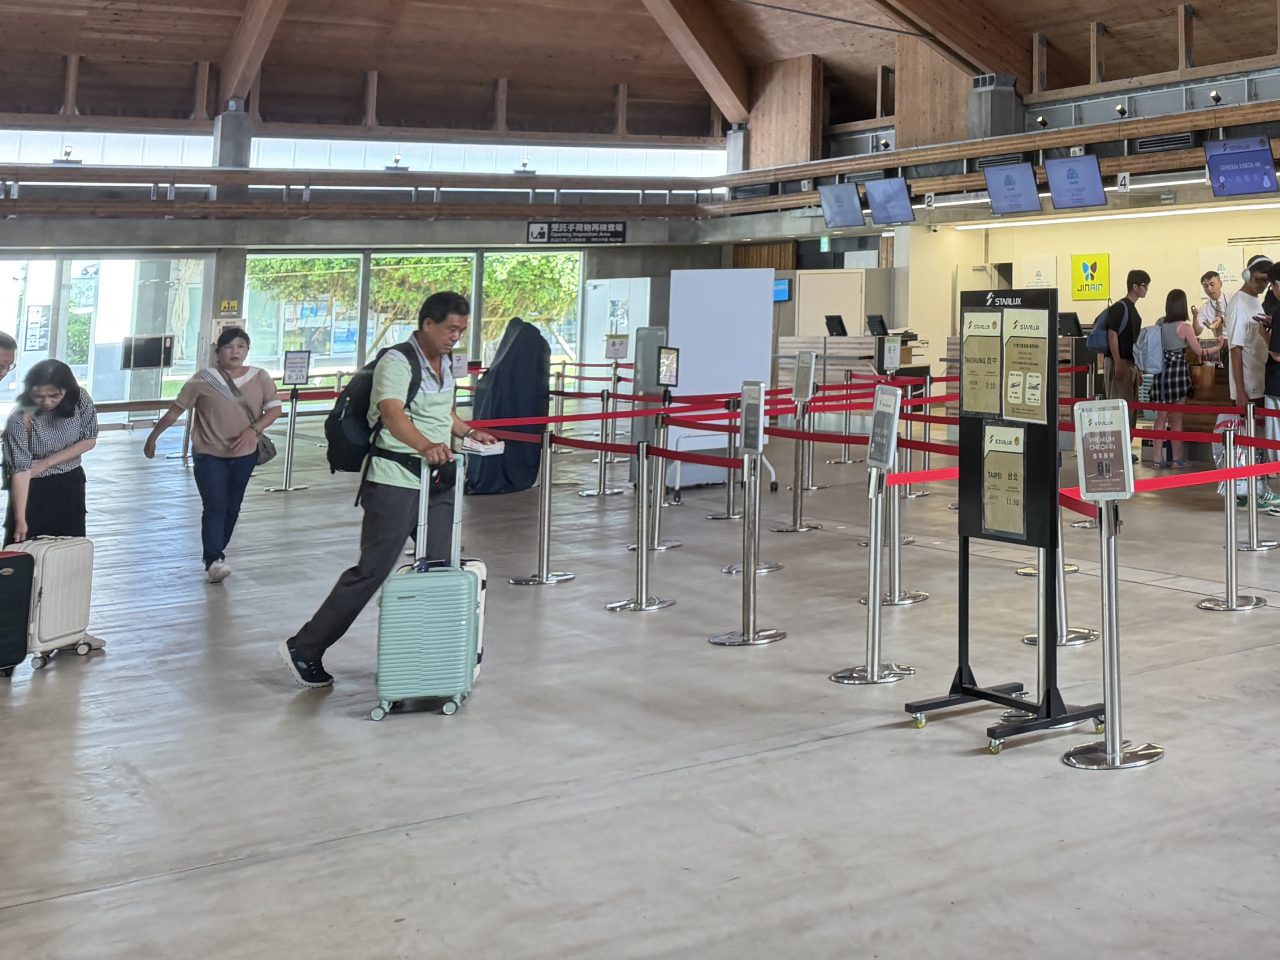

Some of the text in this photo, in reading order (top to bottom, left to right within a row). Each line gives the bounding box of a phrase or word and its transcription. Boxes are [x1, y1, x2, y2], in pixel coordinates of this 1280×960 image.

[1119, 175, 1127, 189] 4
[926, 195, 933, 207] 2
[994, 297, 1022, 306] STARLUX
